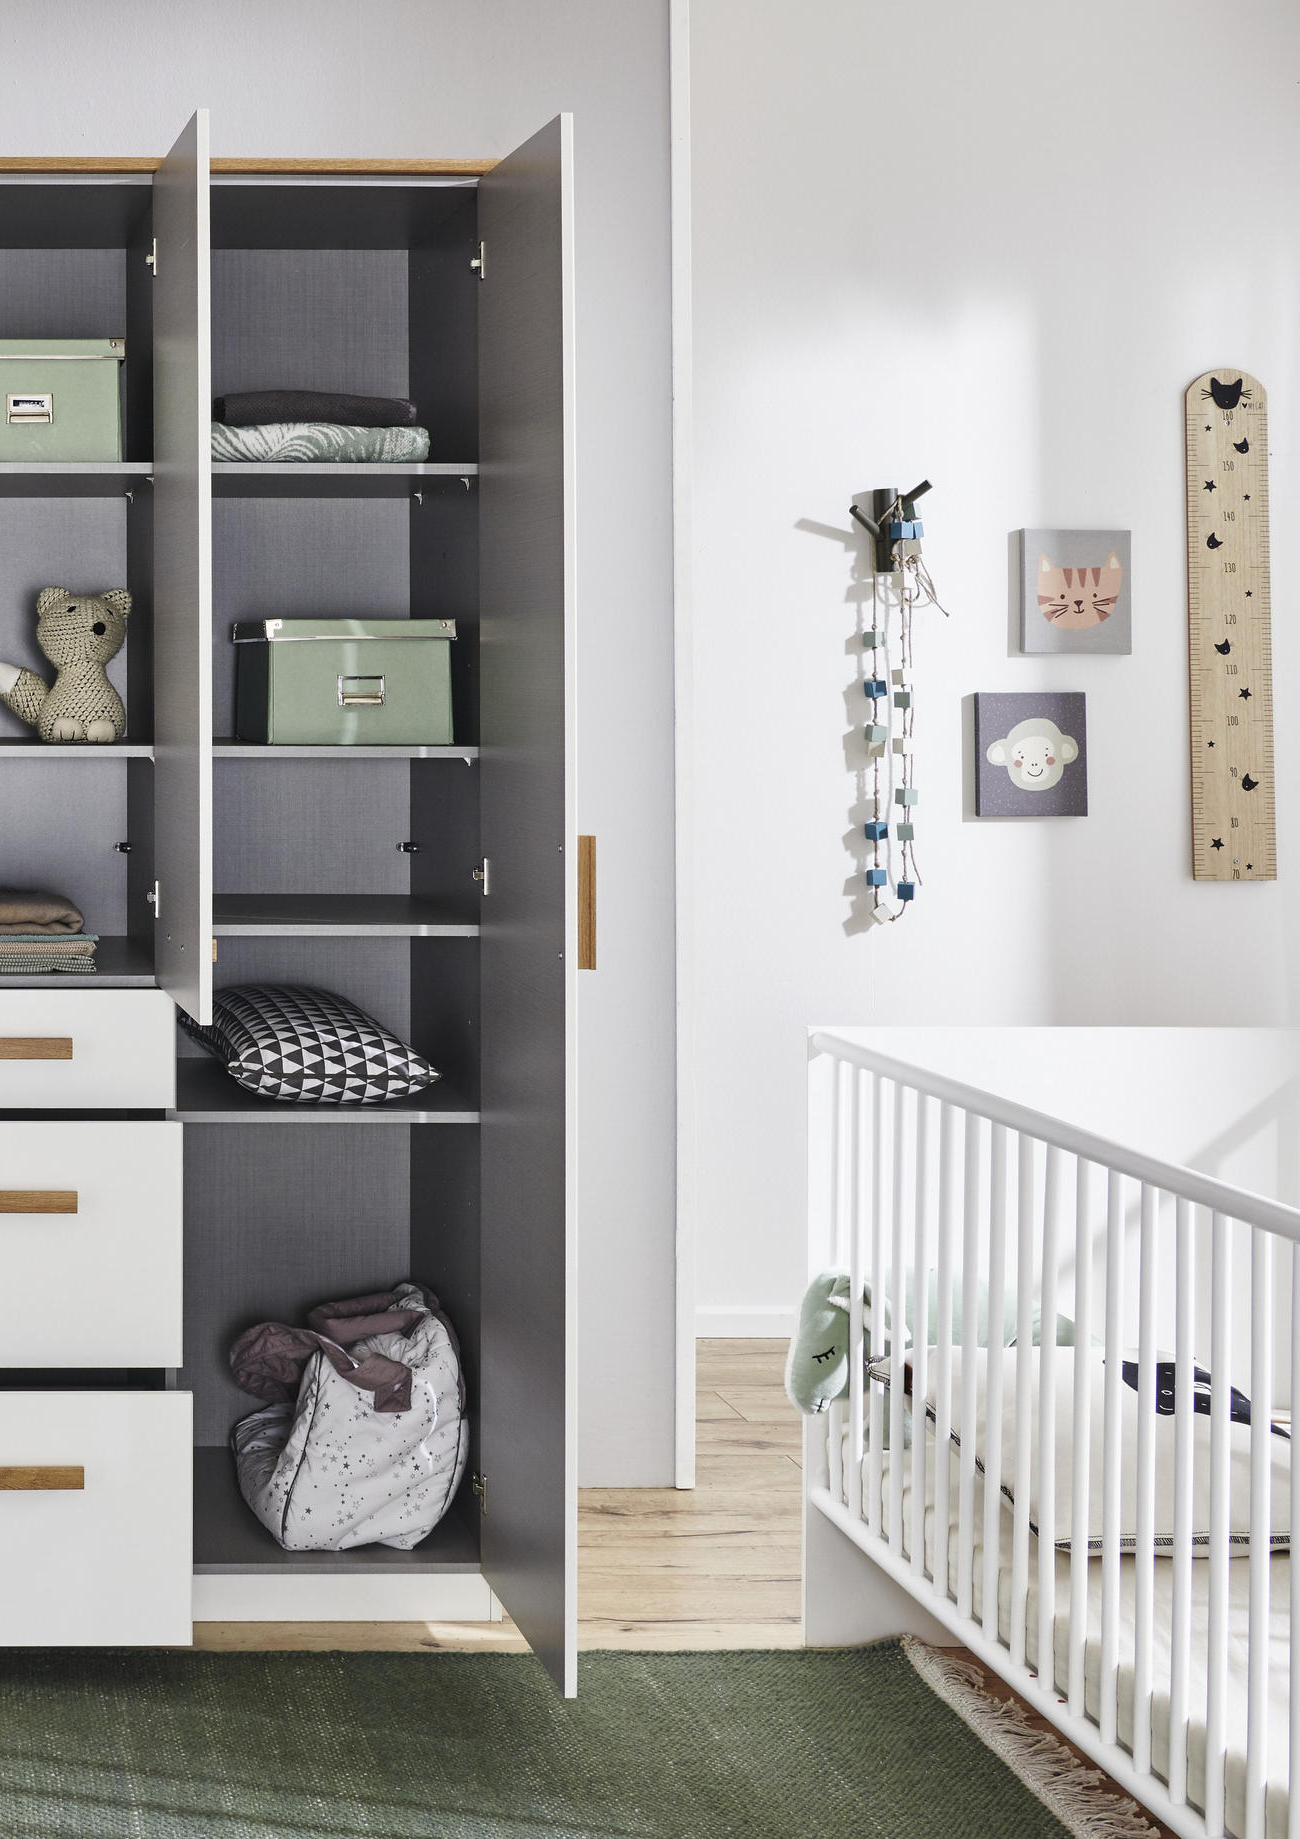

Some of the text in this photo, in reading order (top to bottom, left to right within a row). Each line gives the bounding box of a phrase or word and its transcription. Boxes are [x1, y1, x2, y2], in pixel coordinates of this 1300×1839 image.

[1222, 411, 1234, 421] 160
[1222, 461, 1235, 471] 150
[1223, 511, 1235, 522] 140
[1224, 563, 1236, 573] 130
[1224, 614, 1237, 625] 120
[1225, 665, 1238, 675] 110
[1226, 716, 1239, 726] 100
[1229, 767, 1238, 778] 90
[1230, 817, 1239, 828] 80
[1232, 869, 1240, 880] 70
